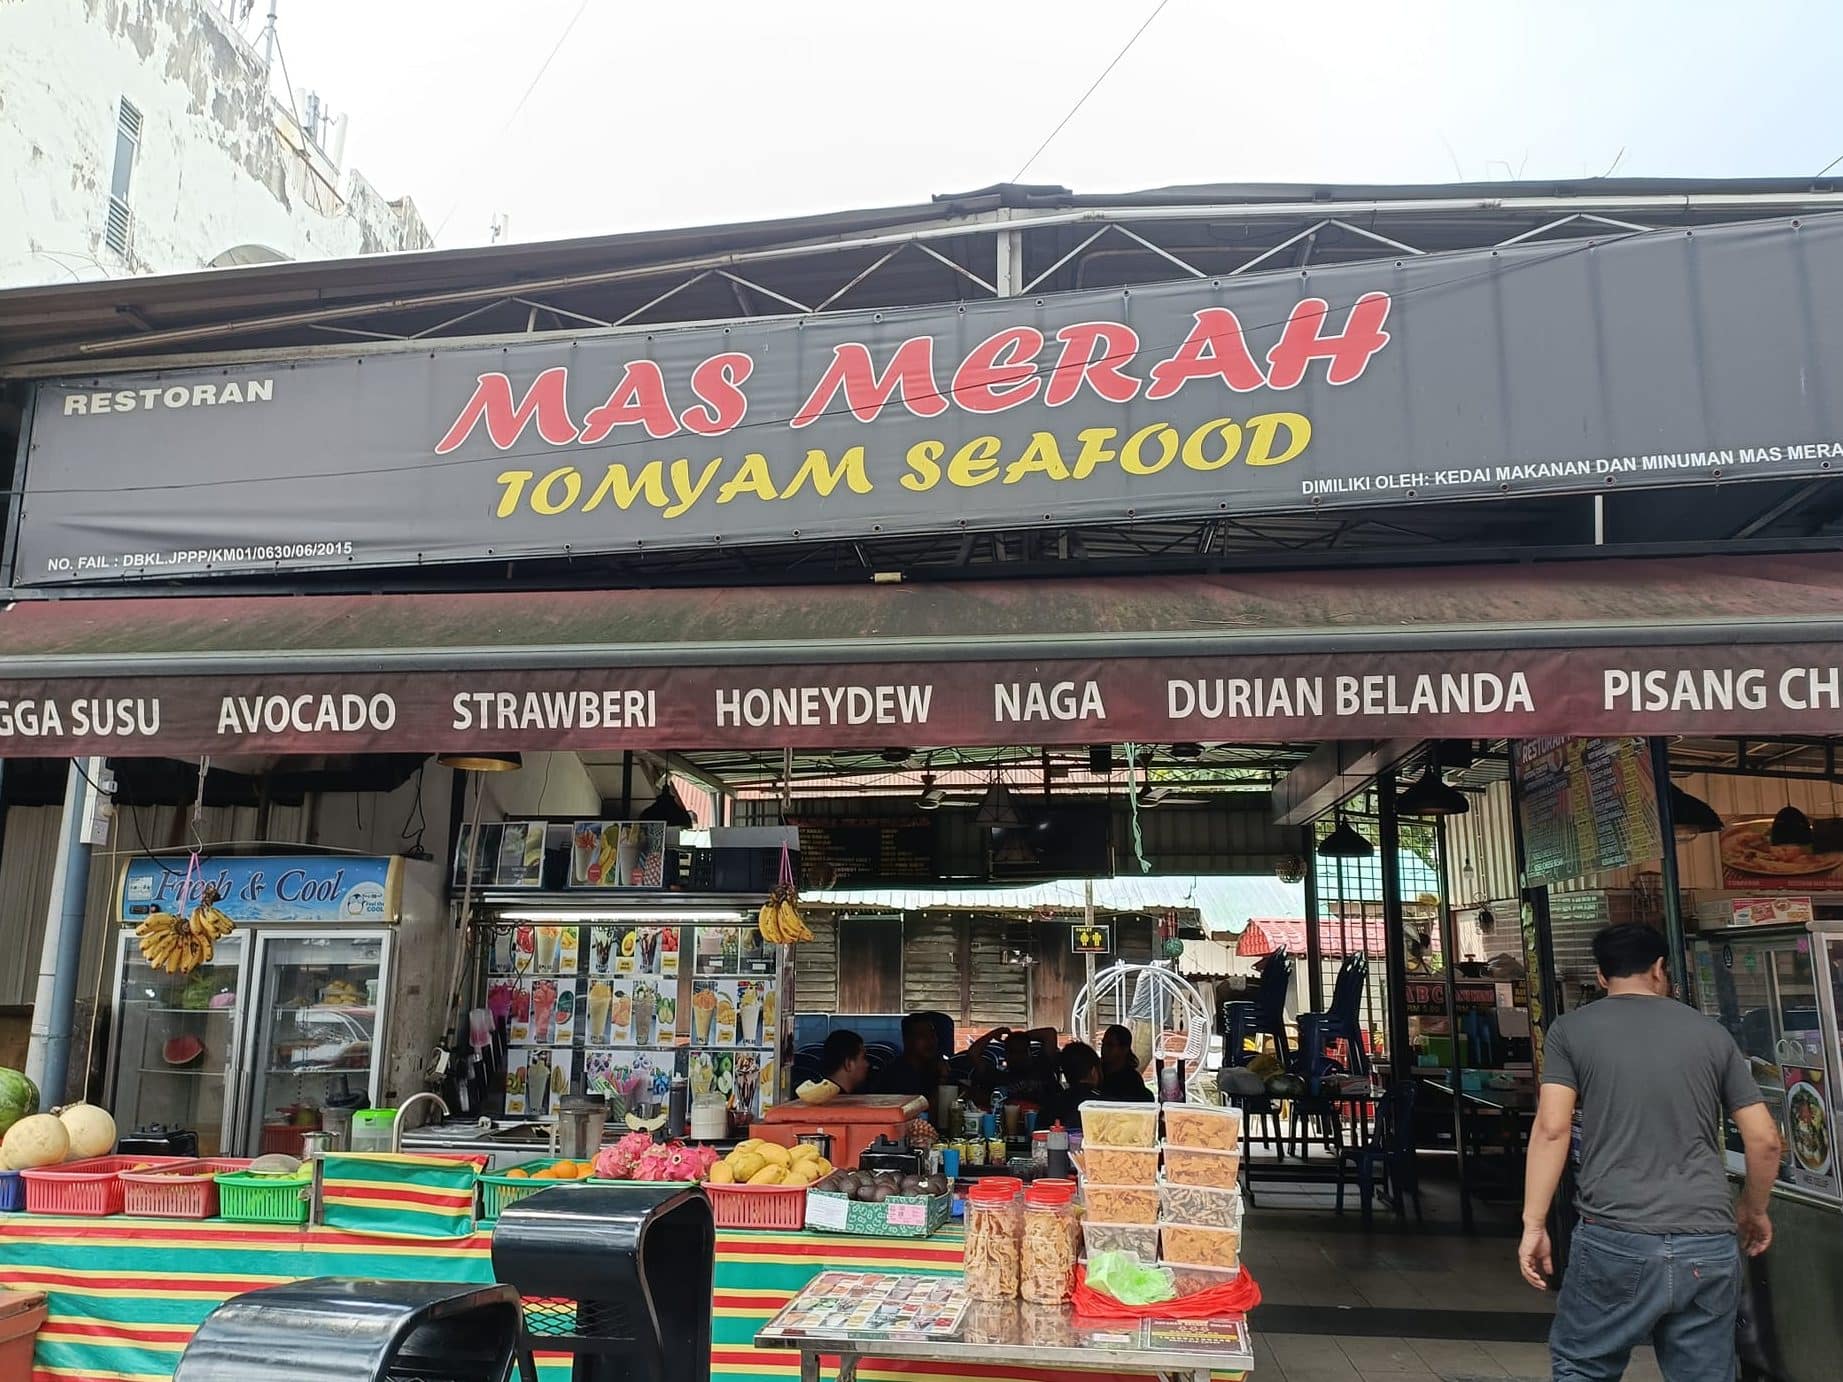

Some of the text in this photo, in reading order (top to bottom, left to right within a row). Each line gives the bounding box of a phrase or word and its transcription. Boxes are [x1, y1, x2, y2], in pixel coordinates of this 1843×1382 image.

[435, 290, 1392, 454] MAS MERAH
[63, 379, 274, 416] RESTORAN
[496, 411, 1313, 519] TOMYAM SEAFOOD
[1302, 442, 1843, 494] DIMILIKI OLEH: KEDAI MAKANAN DAN MINUMAN MAS MERA
[47, 558, 73, 571] NO.
[78, 555, 110, 569] FAIL
[123, 541, 353, 566] DBKL.JPPP/KM01/0630/06/2015
[452, 689, 657, 730] STRAWBERI
[715, 684, 934, 727] HONEYDEW
[994, 680, 1107, 722] NAGA
[1167, 671, 1536, 719] DURIAN BELANDA
[1603, 667, 1841, 712] PISANG CH
[72, 698, 161, 736] SUSU
[217, 692, 397, 735] AVOCADO
[240, 871, 267, 901] &
[275, 868, 345, 902] Cool
